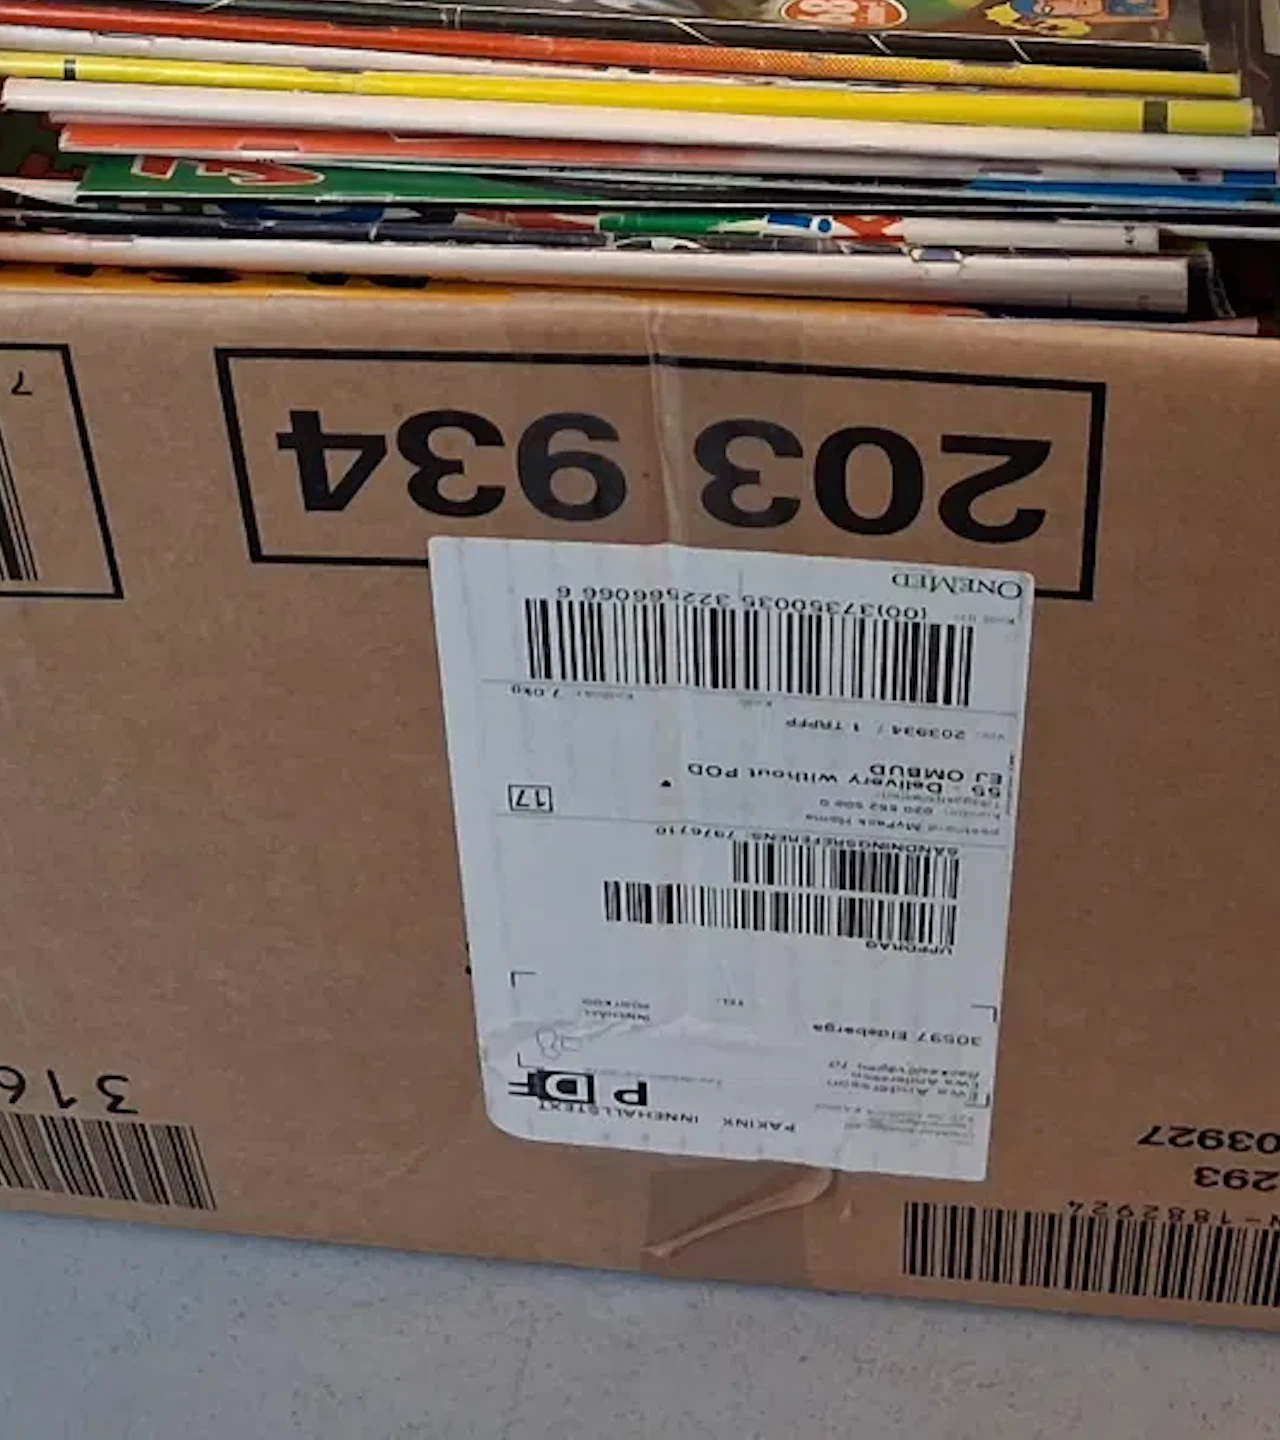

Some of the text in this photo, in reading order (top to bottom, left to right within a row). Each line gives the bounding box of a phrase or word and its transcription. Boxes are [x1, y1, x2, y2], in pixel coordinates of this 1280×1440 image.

[9, 370, 32, 395] 7
[276, 409, 1054, 544] 203 934
[687, 763, 739, 779] POD
[748, 768, 837, 785] without
[868, 763, 1002, 785] EJ OMBUD
[848, 774, 943, 795] Delivery
[516, 788, 546, 807] 17
